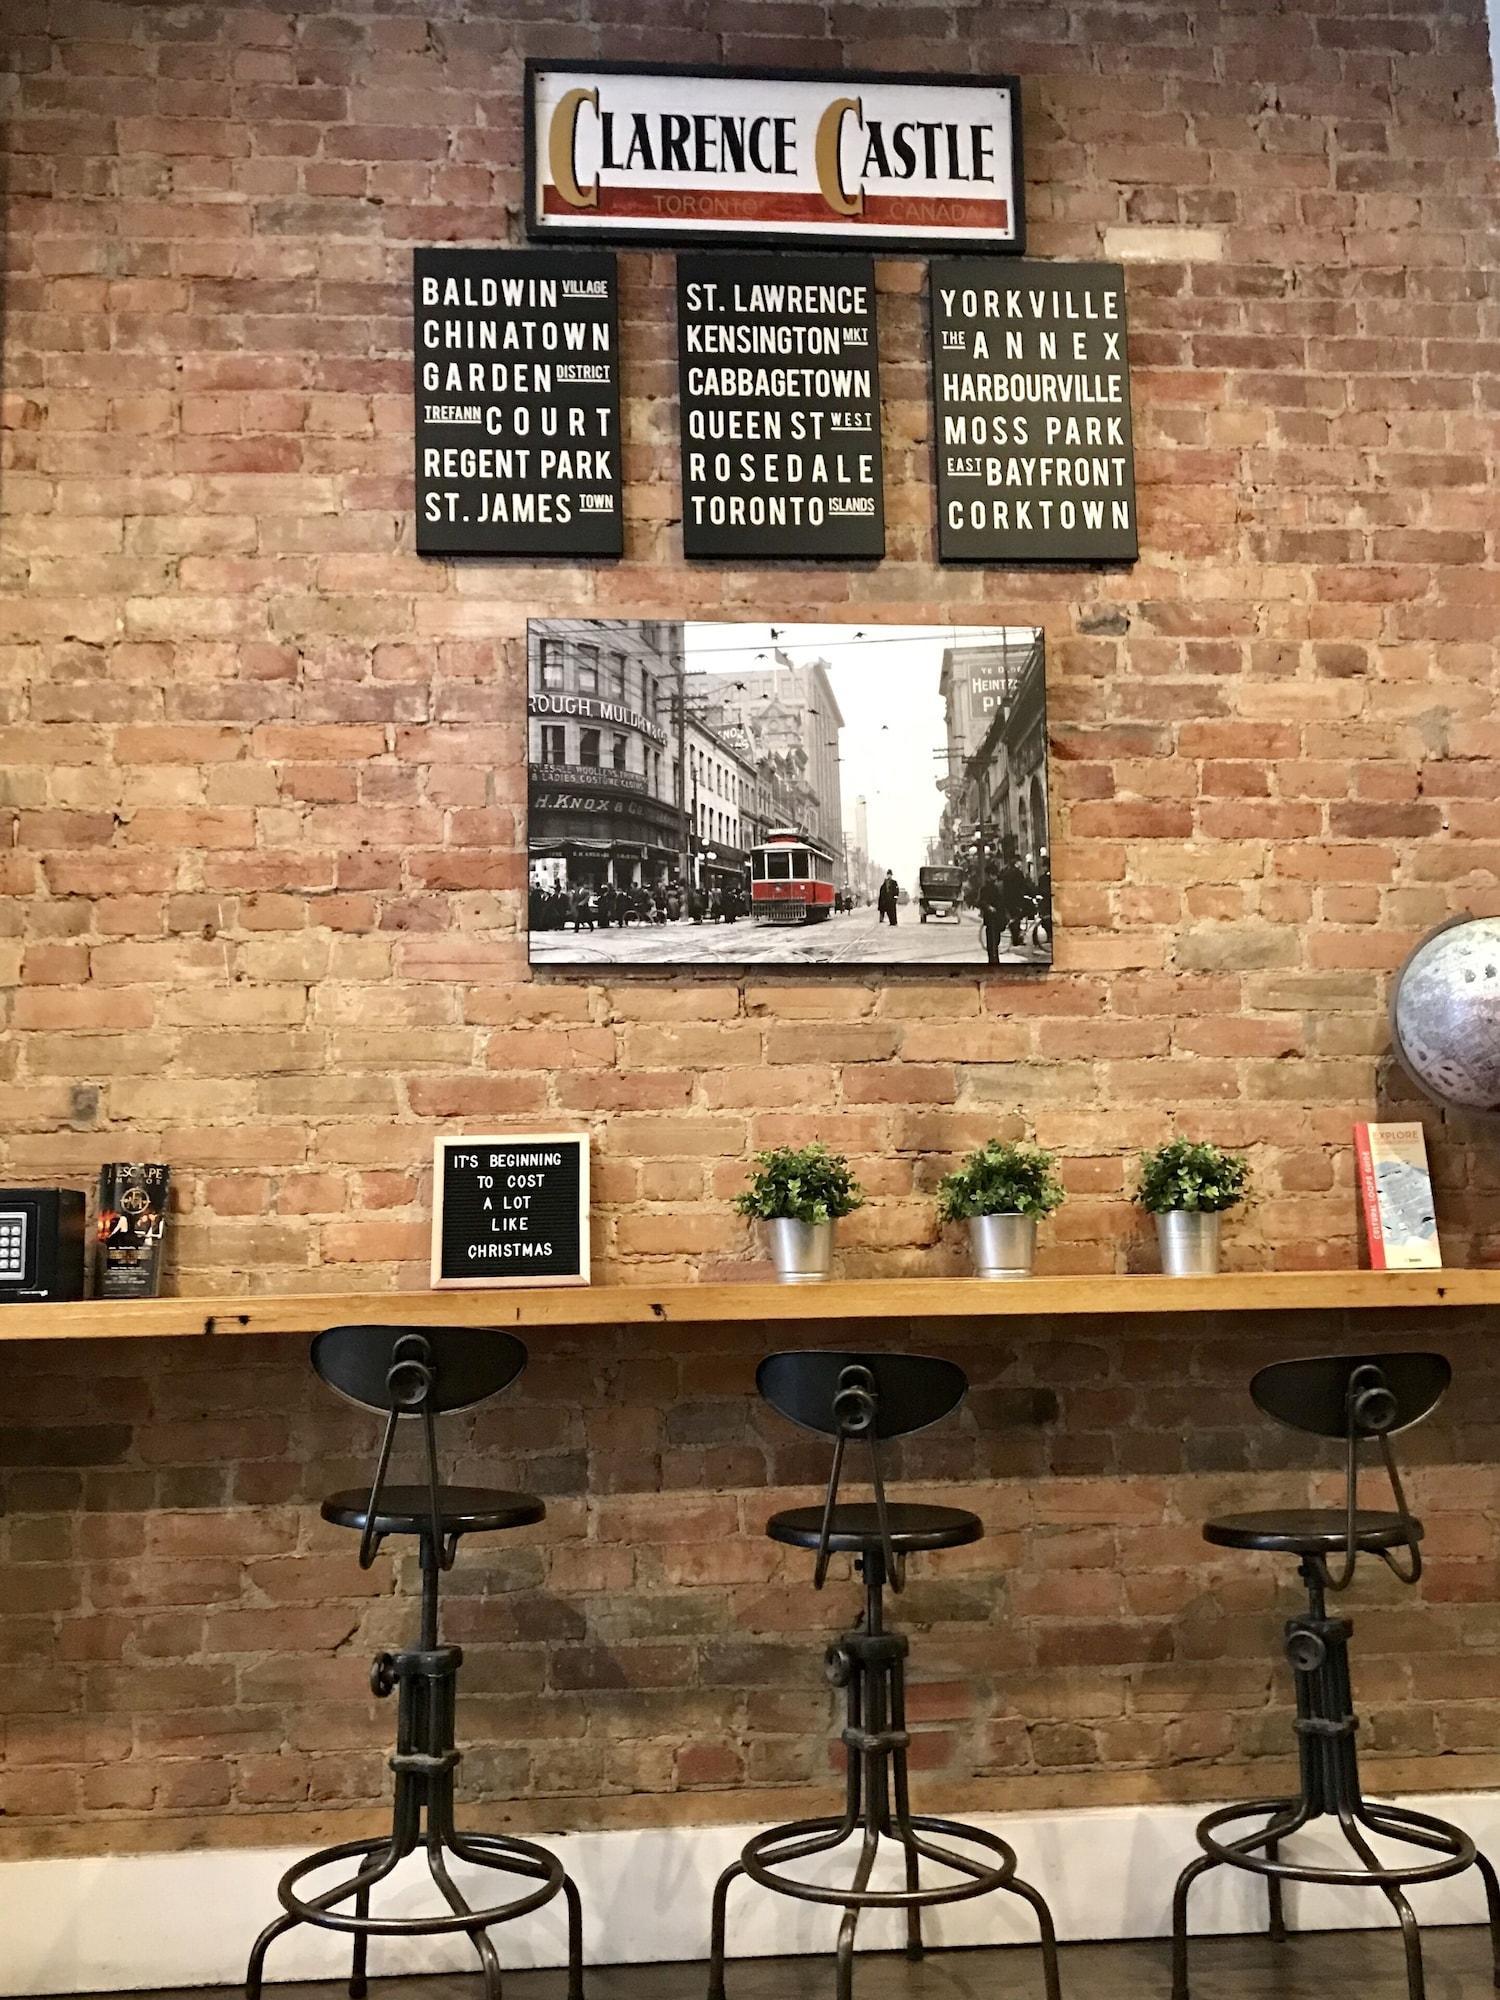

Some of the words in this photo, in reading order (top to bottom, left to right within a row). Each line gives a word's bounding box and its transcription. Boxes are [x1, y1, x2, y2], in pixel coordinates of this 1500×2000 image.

[548, 86, 798, 208] CLARENCE
[815, 96, 994, 216] CASTLE
[653, 193, 762, 215] TORONTO
[889, 202, 979, 222] CANADA
[422, 277, 558, 308] BALDWIN
[562, 280, 608, 294] VILLAGE
[686, 283, 725, 312] ST.
[734, 284, 868, 314] LAWRENCE
[940, 290, 1118, 319] YORKVILLE
[423, 320, 610, 351] CHINATOWN
[686, 324, 840, 355] KENSINGTON
[843, 328, 868, 342] MKT
[942, 330, 966, 346] THE
[973, 331, 1120, 360] ANNEX
[423, 362, 552, 392] GARDEN
[556, 364, 610, 379] DISTRICT
[688, 368, 871, 398] CABBAGETOWN
[943, 374, 1122, 402] HARBOURVILLE
[424, 406, 482, 420] TREFANN
[486, 406, 611, 436] COURT
[689, 410, 782, 440] QUEEN
[790, 412, 824, 440] ST
[831, 412, 872, 427] WEST
[944, 416, 1028, 445] MOSS
[1046, 417, 1124, 445] PARK
[424, 448, 530, 478] REGENT
[541, 450, 612, 480] PARK
[690, 453, 874, 483] ROSEDALE
[948, 458, 982, 472] EAST
[986, 458, 1126, 486] BAYFRONT
[424, 492, 469, 522] ST.
[477, 493, 572, 524] JAMES
[580, 494, 614, 508] TOWN
[691, 496, 824, 526] TORONTO
[829, 498, 875, 512] ISLANDS
[949, 500, 1130, 530] CORKTOWN
[453, 1155, 479, 1169] IT'S
[489, 1152, 562, 1168] BEGINNING
[477, 1175, 494, 1189] TO
[507, 1174, 545, 1188] COST
[483, 1196, 493, 1210] A
[503, 1196, 531, 1210] LOT
[491, 1217, 529, 1232] LIKE
[467, 1242, 553, 1259] CHRISTMAS
